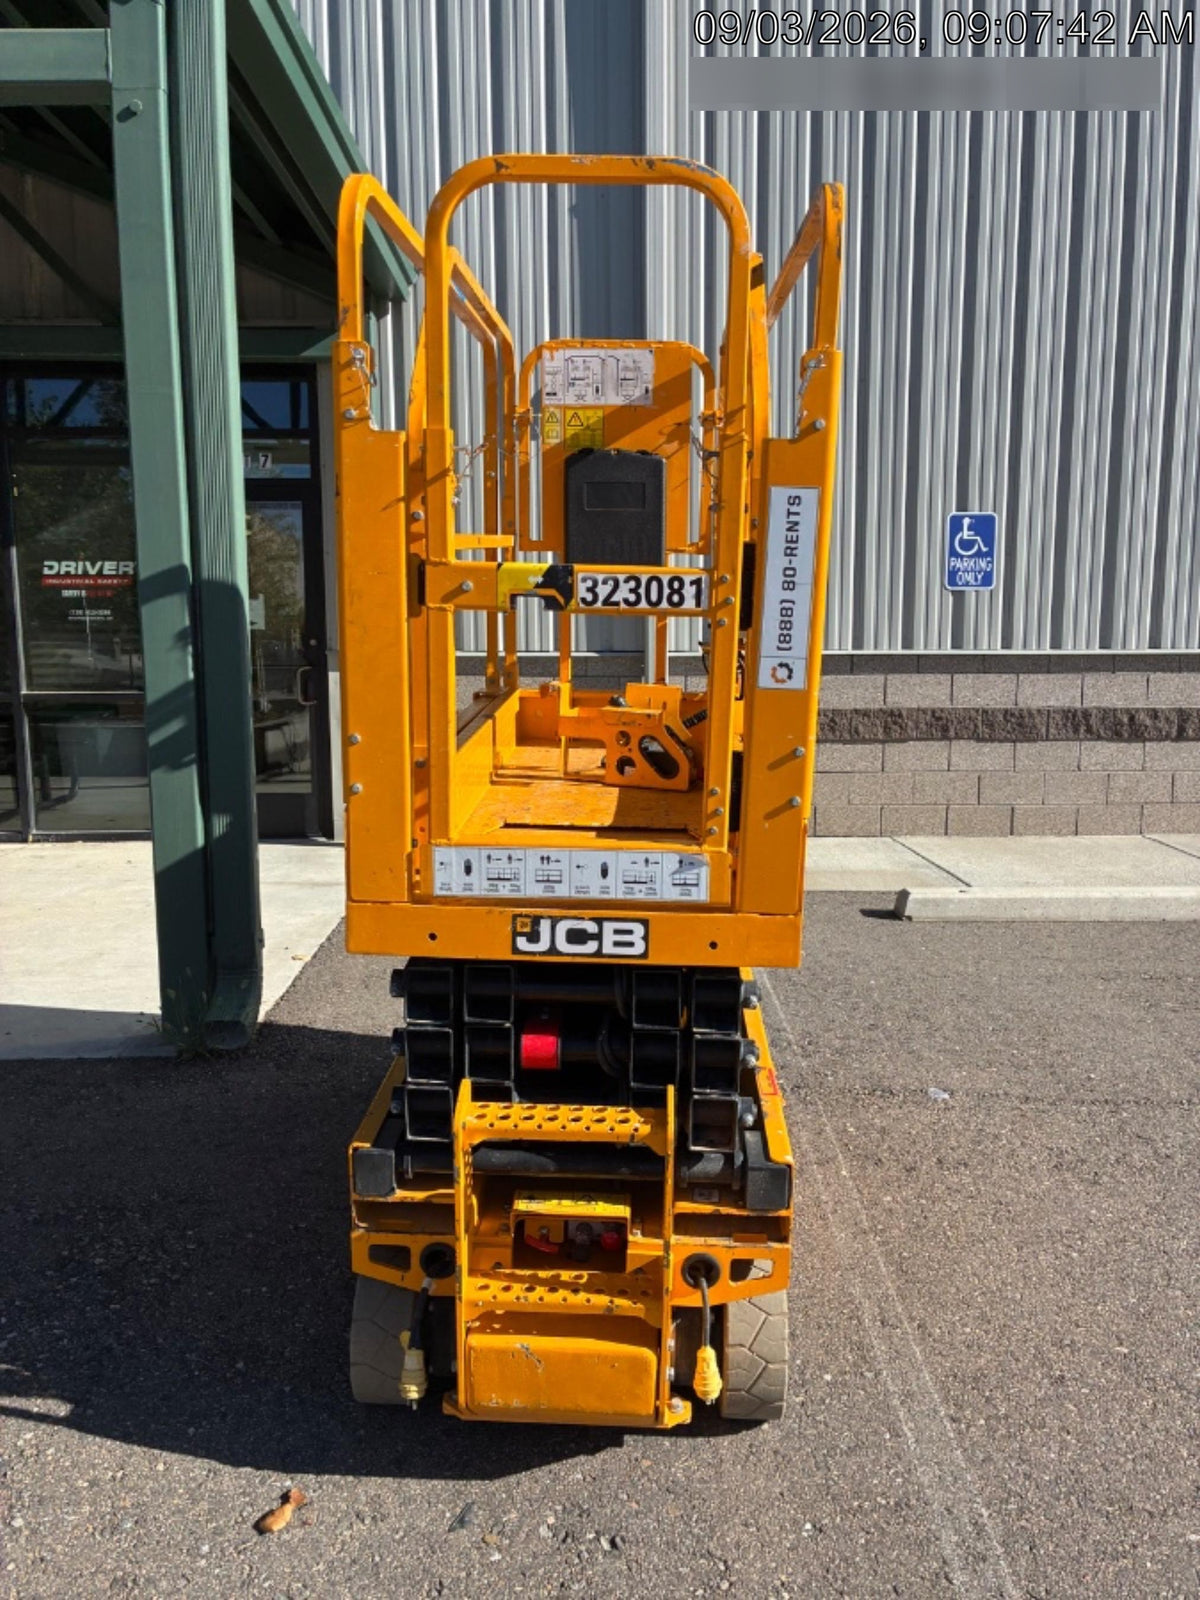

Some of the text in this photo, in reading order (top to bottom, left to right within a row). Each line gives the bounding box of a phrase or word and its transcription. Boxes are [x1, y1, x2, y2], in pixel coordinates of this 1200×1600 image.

[43, 561, 135, 575] DRIVER
[776, 495, 802, 652] (888) 80-RENTS
[950, 558, 992, 571] PARKING
[956, 572, 984, 585] ONLY
[580, 575, 703, 609] 323081
[516, 918, 646, 956] JCB
